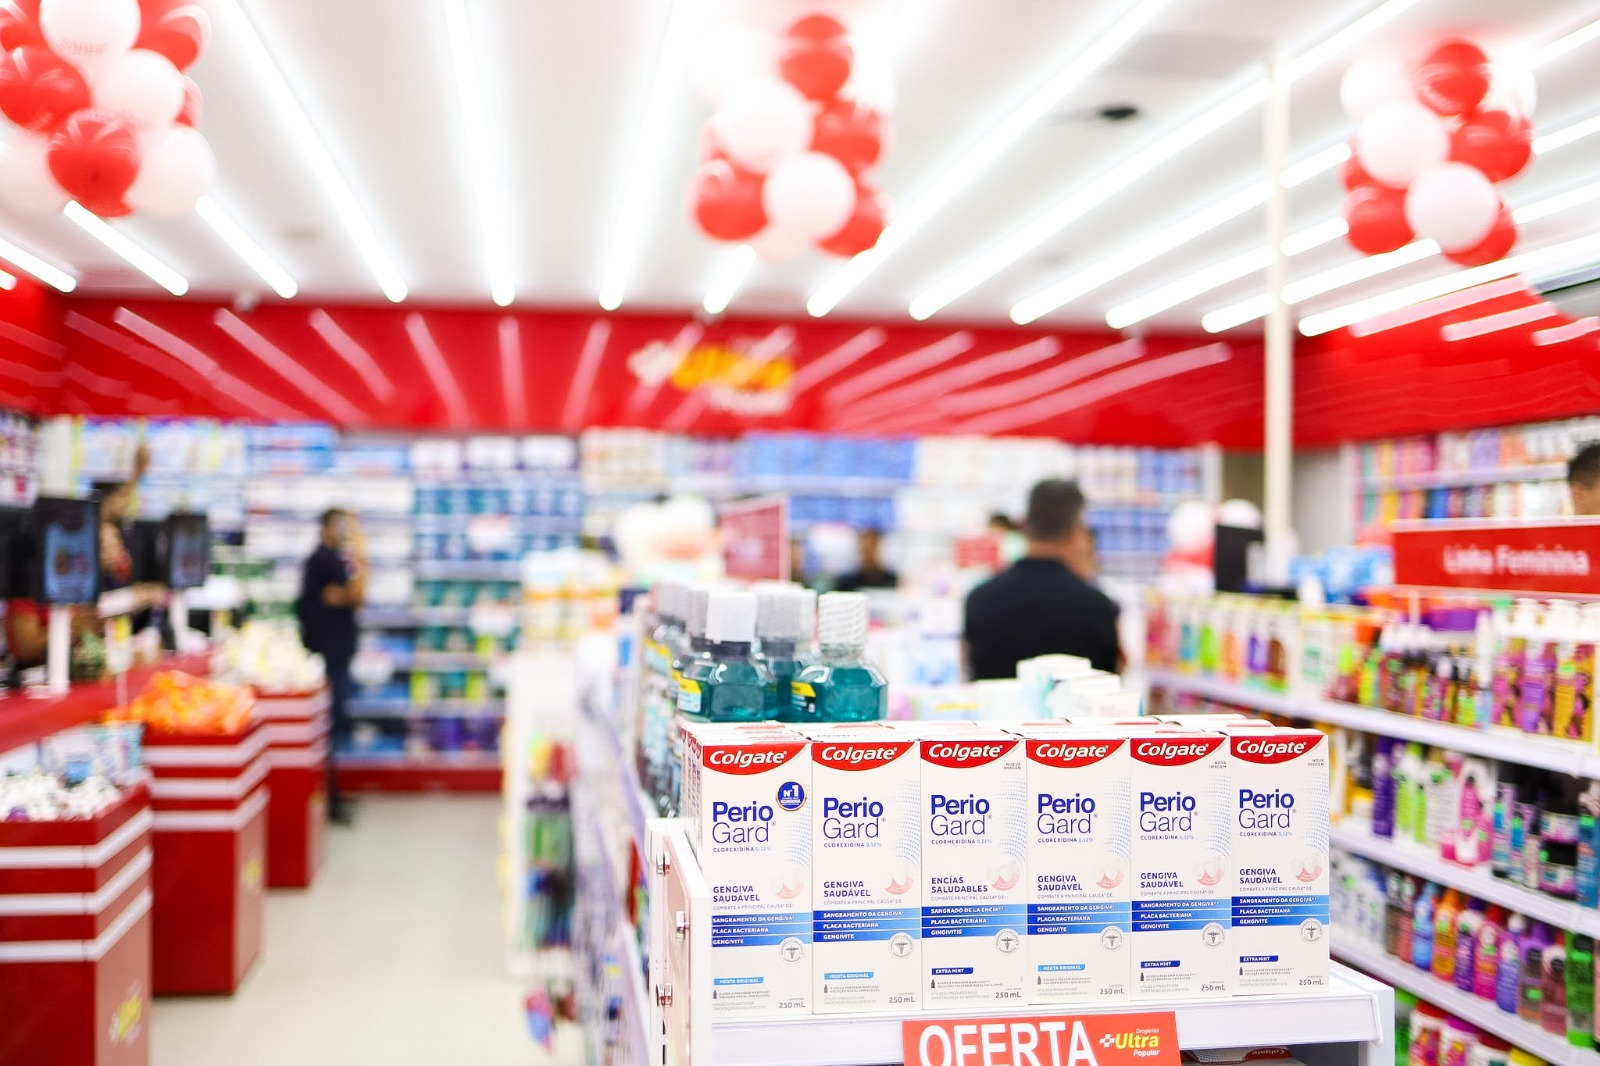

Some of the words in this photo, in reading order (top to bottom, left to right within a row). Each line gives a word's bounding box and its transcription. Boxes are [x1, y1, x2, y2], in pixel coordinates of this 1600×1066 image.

[822, 747, 894, 764] Colgate
[929, 744, 1001, 761] Colgate
[1036, 744, 1106, 761] Colgate
[1138, 743, 1206, 759] Colgate
[1237, 740, 1304, 757] Colgate
[710, 751, 784, 768] Colgate
[931, 794, 989, 815] Perio
[1038, 793, 1095, 813] Perio
[1140, 792, 1196, 811] Perio
[1239, 789, 1294, 808] Perio
[713, 801, 773, 822] Perio
[824, 797, 883, 818] Perio
[932, 875, 964, 884] ENCÍAS
[1038, 875, 1076, 883] GENGIVA
[1141, 872, 1177, 880] GENGIVA
[1141, 880, 1184, 888] SAUDÁVEL
[1240, 875, 1282, 884] SAUDÁVEL
[824, 888, 870, 897] SAUDÁVEL
[932, 885, 988, 893] SALUDABLES
[1038, 882, 1082, 891] SAUDÁVEL
[713, 893, 760, 902] SAUDÁVEL
[919, 1021, 1099, 1066] OFERTA
[1115, 1033, 1159, 1049] Ultra
[1133, 1049, 1160, 1058] Popular
